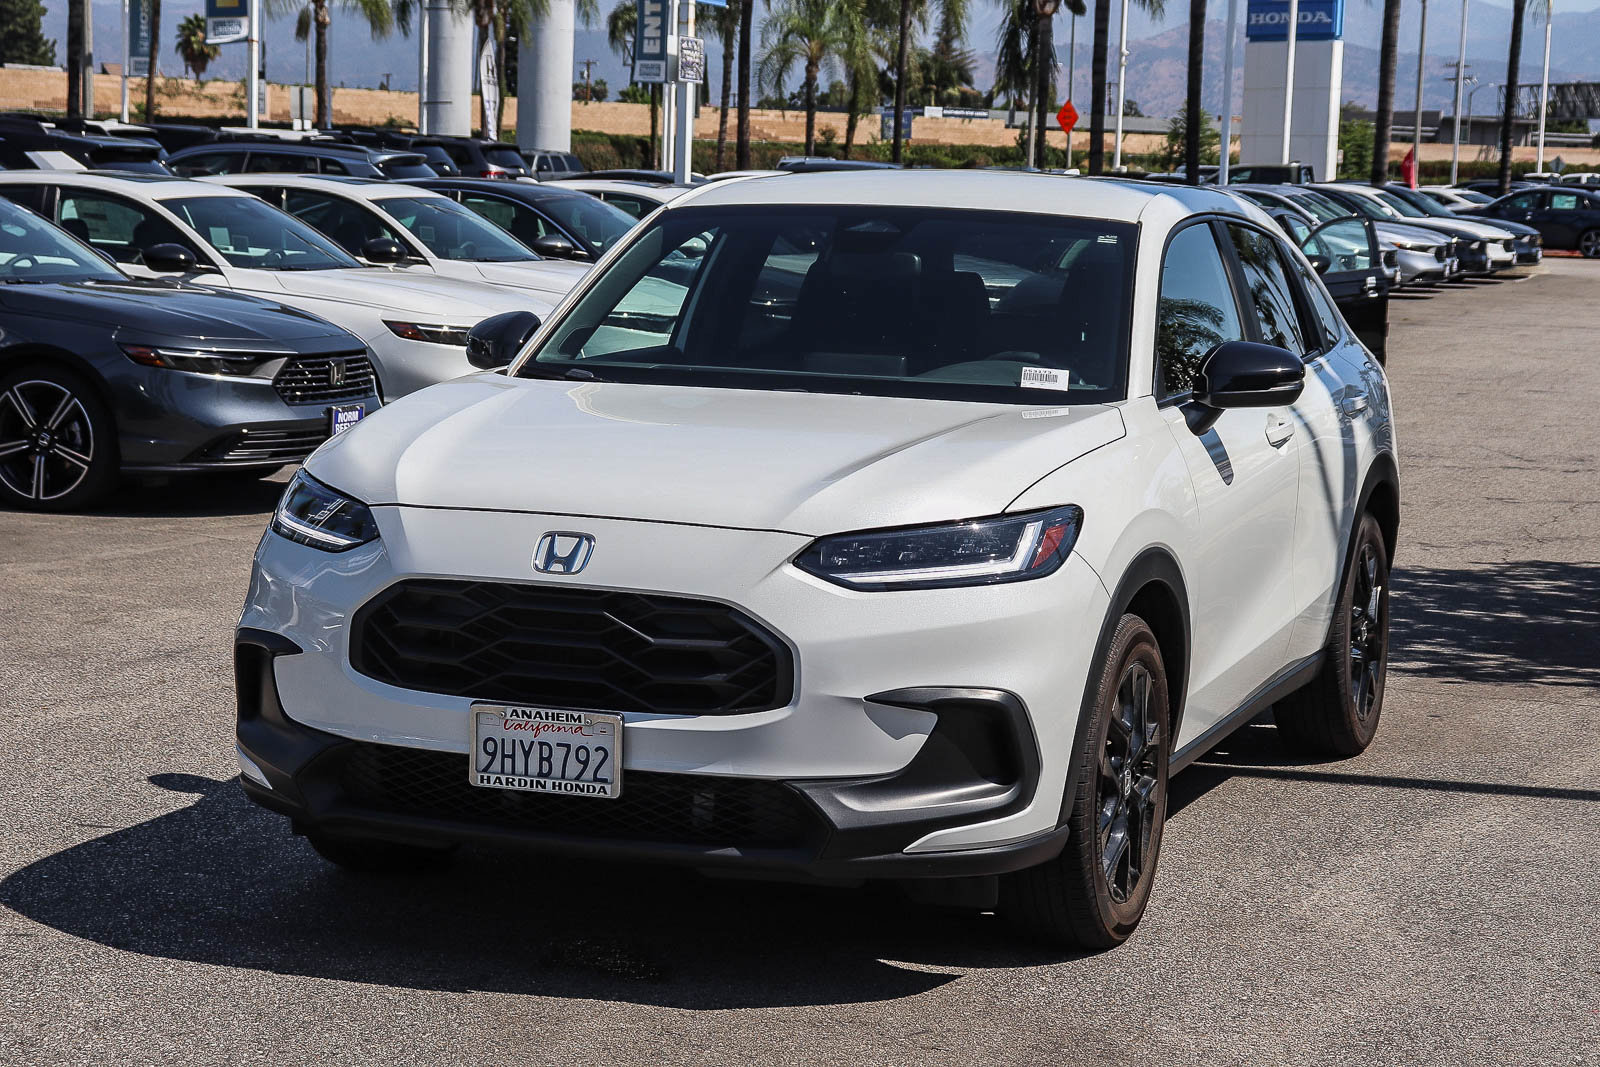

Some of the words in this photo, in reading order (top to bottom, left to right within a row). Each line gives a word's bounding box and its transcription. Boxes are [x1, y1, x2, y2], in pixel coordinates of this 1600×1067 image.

[338, 411, 358, 422] NORM
[509, 709, 583, 724] ANAHEIM
[503, 719, 594, 739] California
[481, 736, 610, 784] 9HYB792
[479, 774, 547, 790] HARDIN
[551, 781, 608, 796] HONDA
